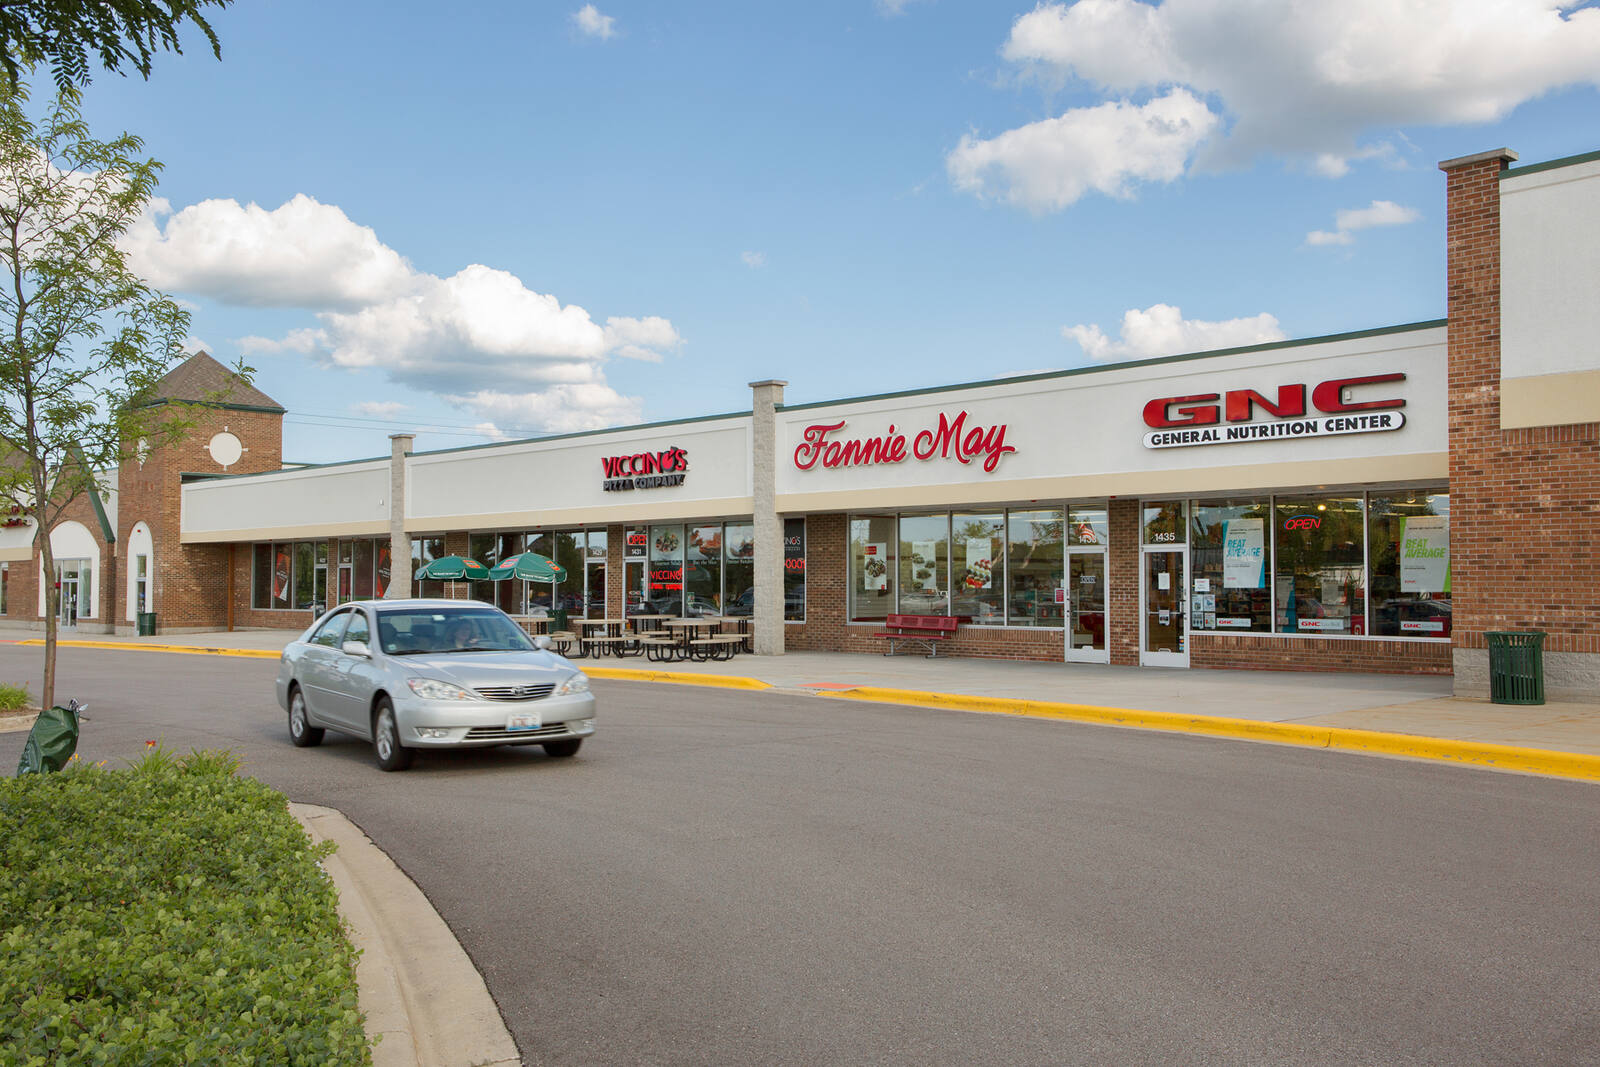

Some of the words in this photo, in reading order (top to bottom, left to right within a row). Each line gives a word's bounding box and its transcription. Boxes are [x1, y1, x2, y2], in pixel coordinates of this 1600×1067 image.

[1143, 373, 1406, 428] GNC
[1151, 431, 1221, 446] GENERAL
[1226, 419, 1322, 440] NUTRITION
[1325, 414, 1392, 432] CENTER
[794, 420, 909, 470] Fannie
[913, 410, 1016, 473] May
[603, 479, 634, 491] PIZZA
[635, 474, 686, 489] COMPANY
[1285, 518, 1321, 530] OPEN
[1155, 532, 1176, 541] 1435
[1406, 538, 1428, 549] BEAT
[1405, 548, 1446, 559] AVERAGE
